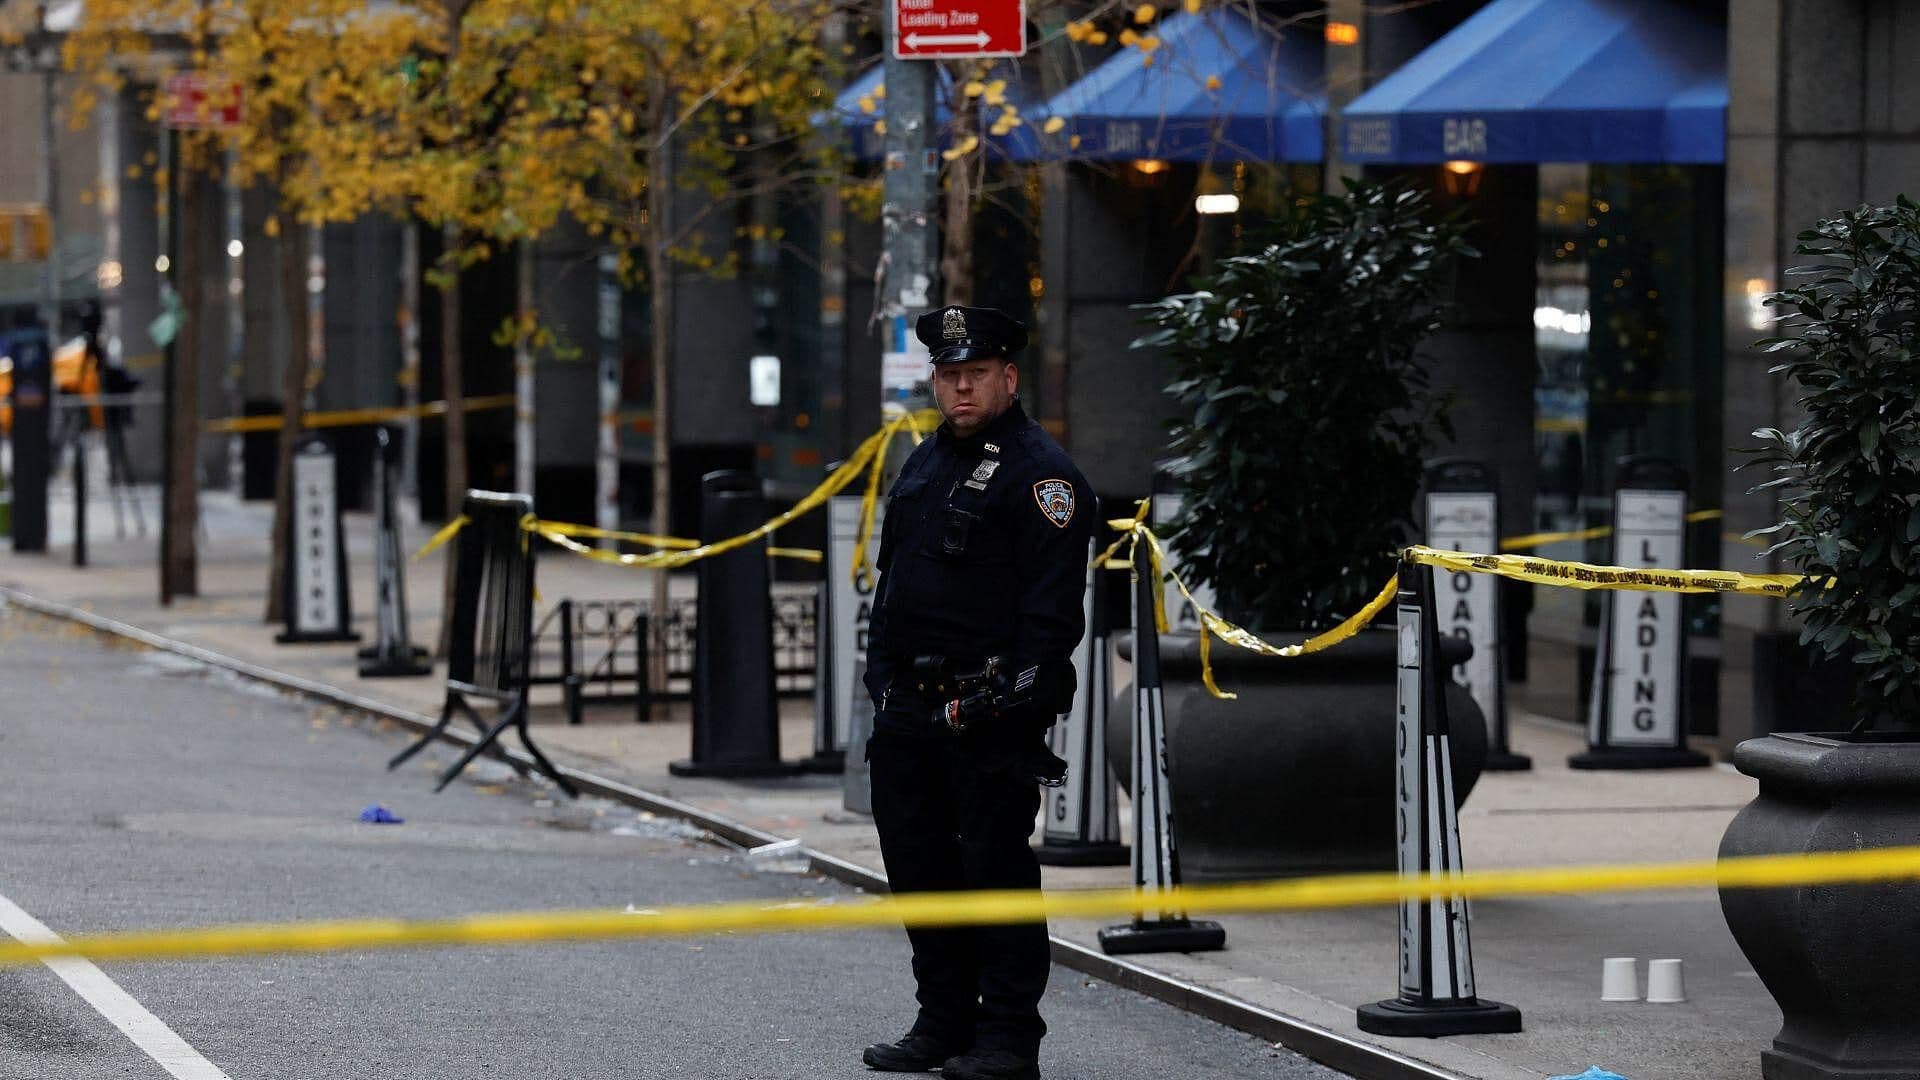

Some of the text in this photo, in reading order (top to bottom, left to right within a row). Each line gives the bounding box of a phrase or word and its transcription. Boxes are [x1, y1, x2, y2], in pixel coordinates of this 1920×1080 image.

[901, 10, 979, 28] Loading Zone
[1443, 119, 1488, 155] BAR
[1560, 566, 1569, 578] DO
[1633, 540, 1658, 733] LADING
